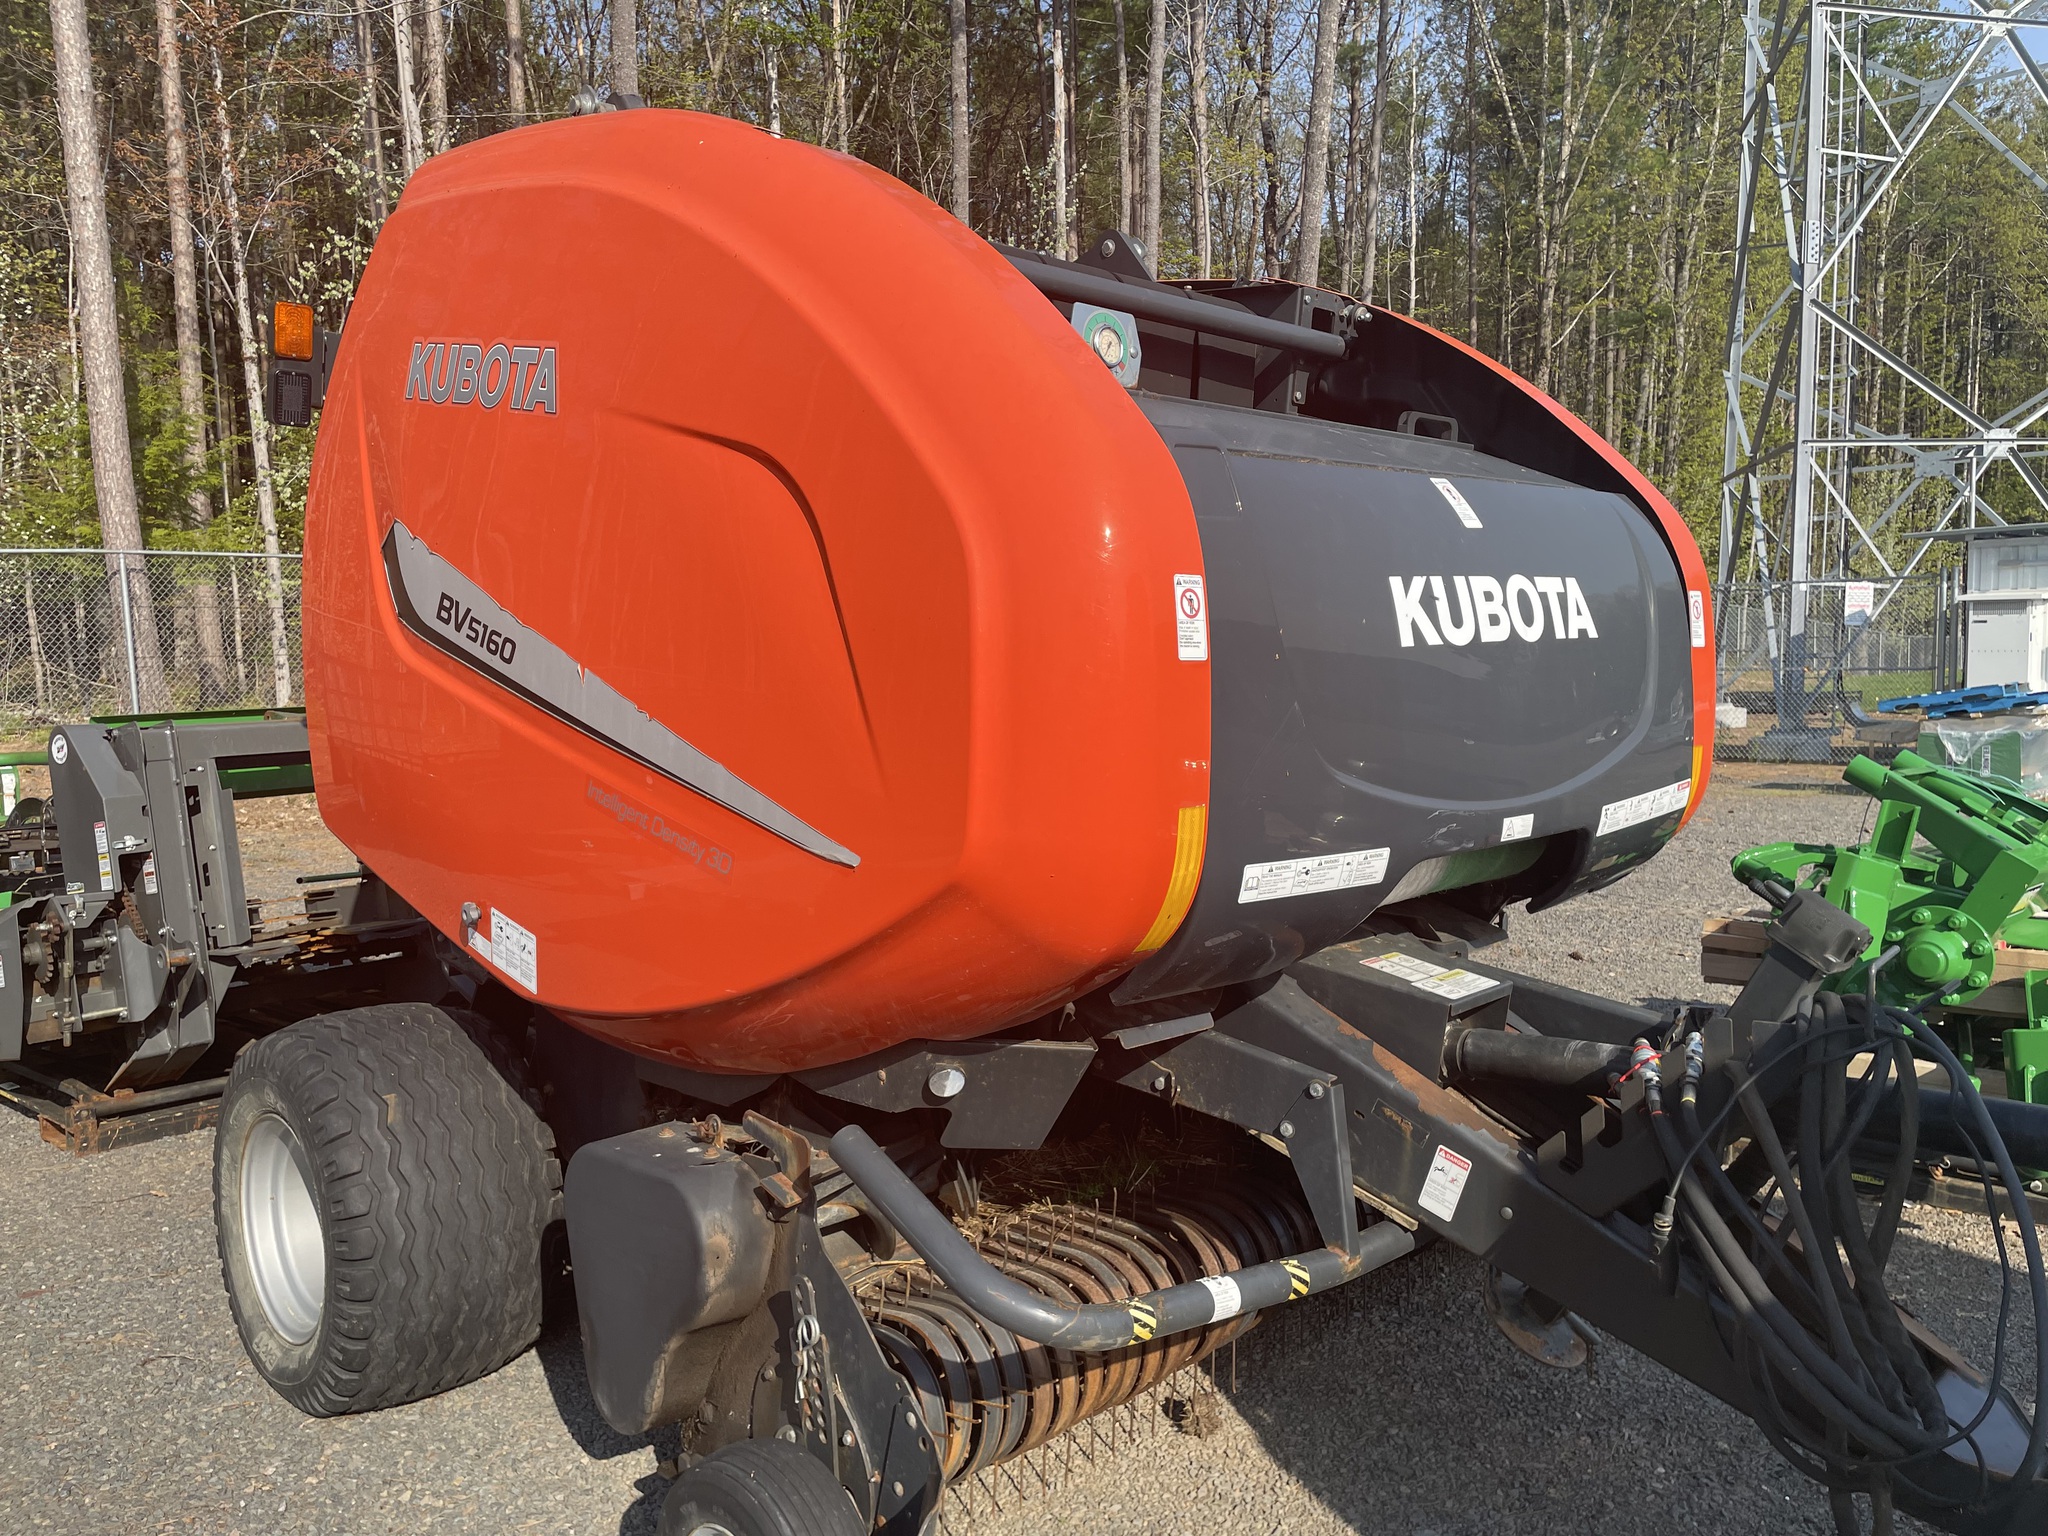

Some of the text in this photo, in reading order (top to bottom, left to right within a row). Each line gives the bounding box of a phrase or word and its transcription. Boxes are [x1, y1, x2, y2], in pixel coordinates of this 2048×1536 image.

[405, 342, 557, 414] KUBOTA
[436, 592, 516, 665] BV5160
[1388, 573, 1599, 648] KUBOTA
[587, 780, 733, 875] Intelligent Density 3D
[1445, 1153, 1469, 1170] DANGER
